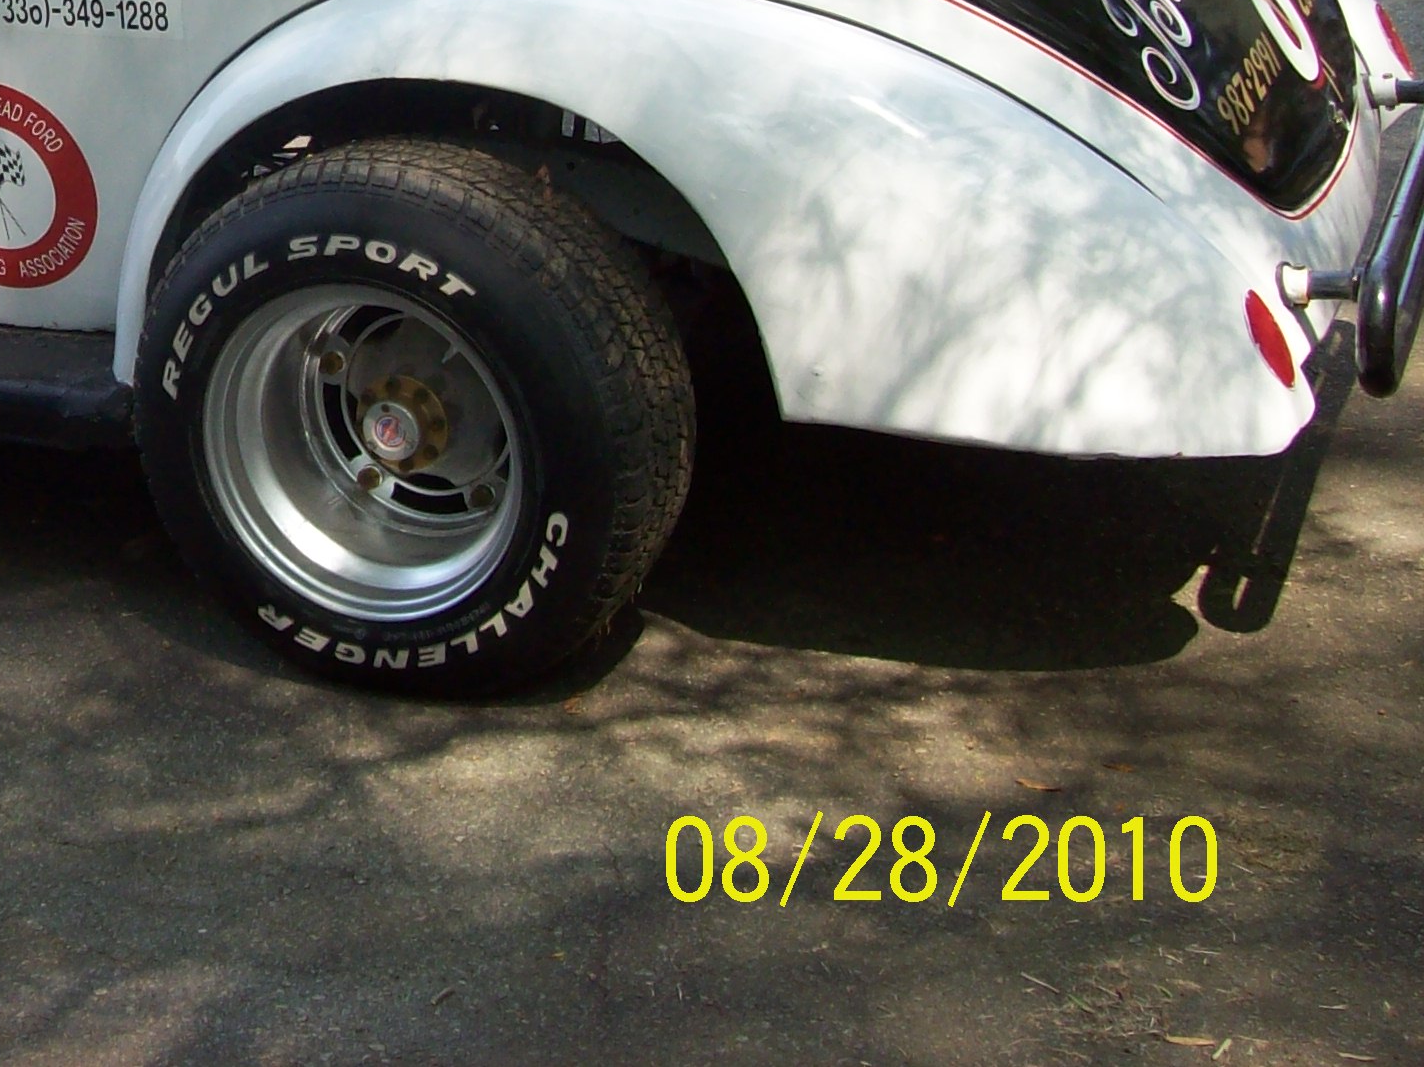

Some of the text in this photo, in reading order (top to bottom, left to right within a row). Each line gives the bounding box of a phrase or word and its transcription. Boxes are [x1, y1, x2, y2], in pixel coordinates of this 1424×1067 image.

[23, 111, 64, 152] FORD
[19, 216, 86, 278] ASSOCIATION
[162, 235, 476, 400] REGUL SPORT
[257, 511, 569, 670] CHALLENGER
